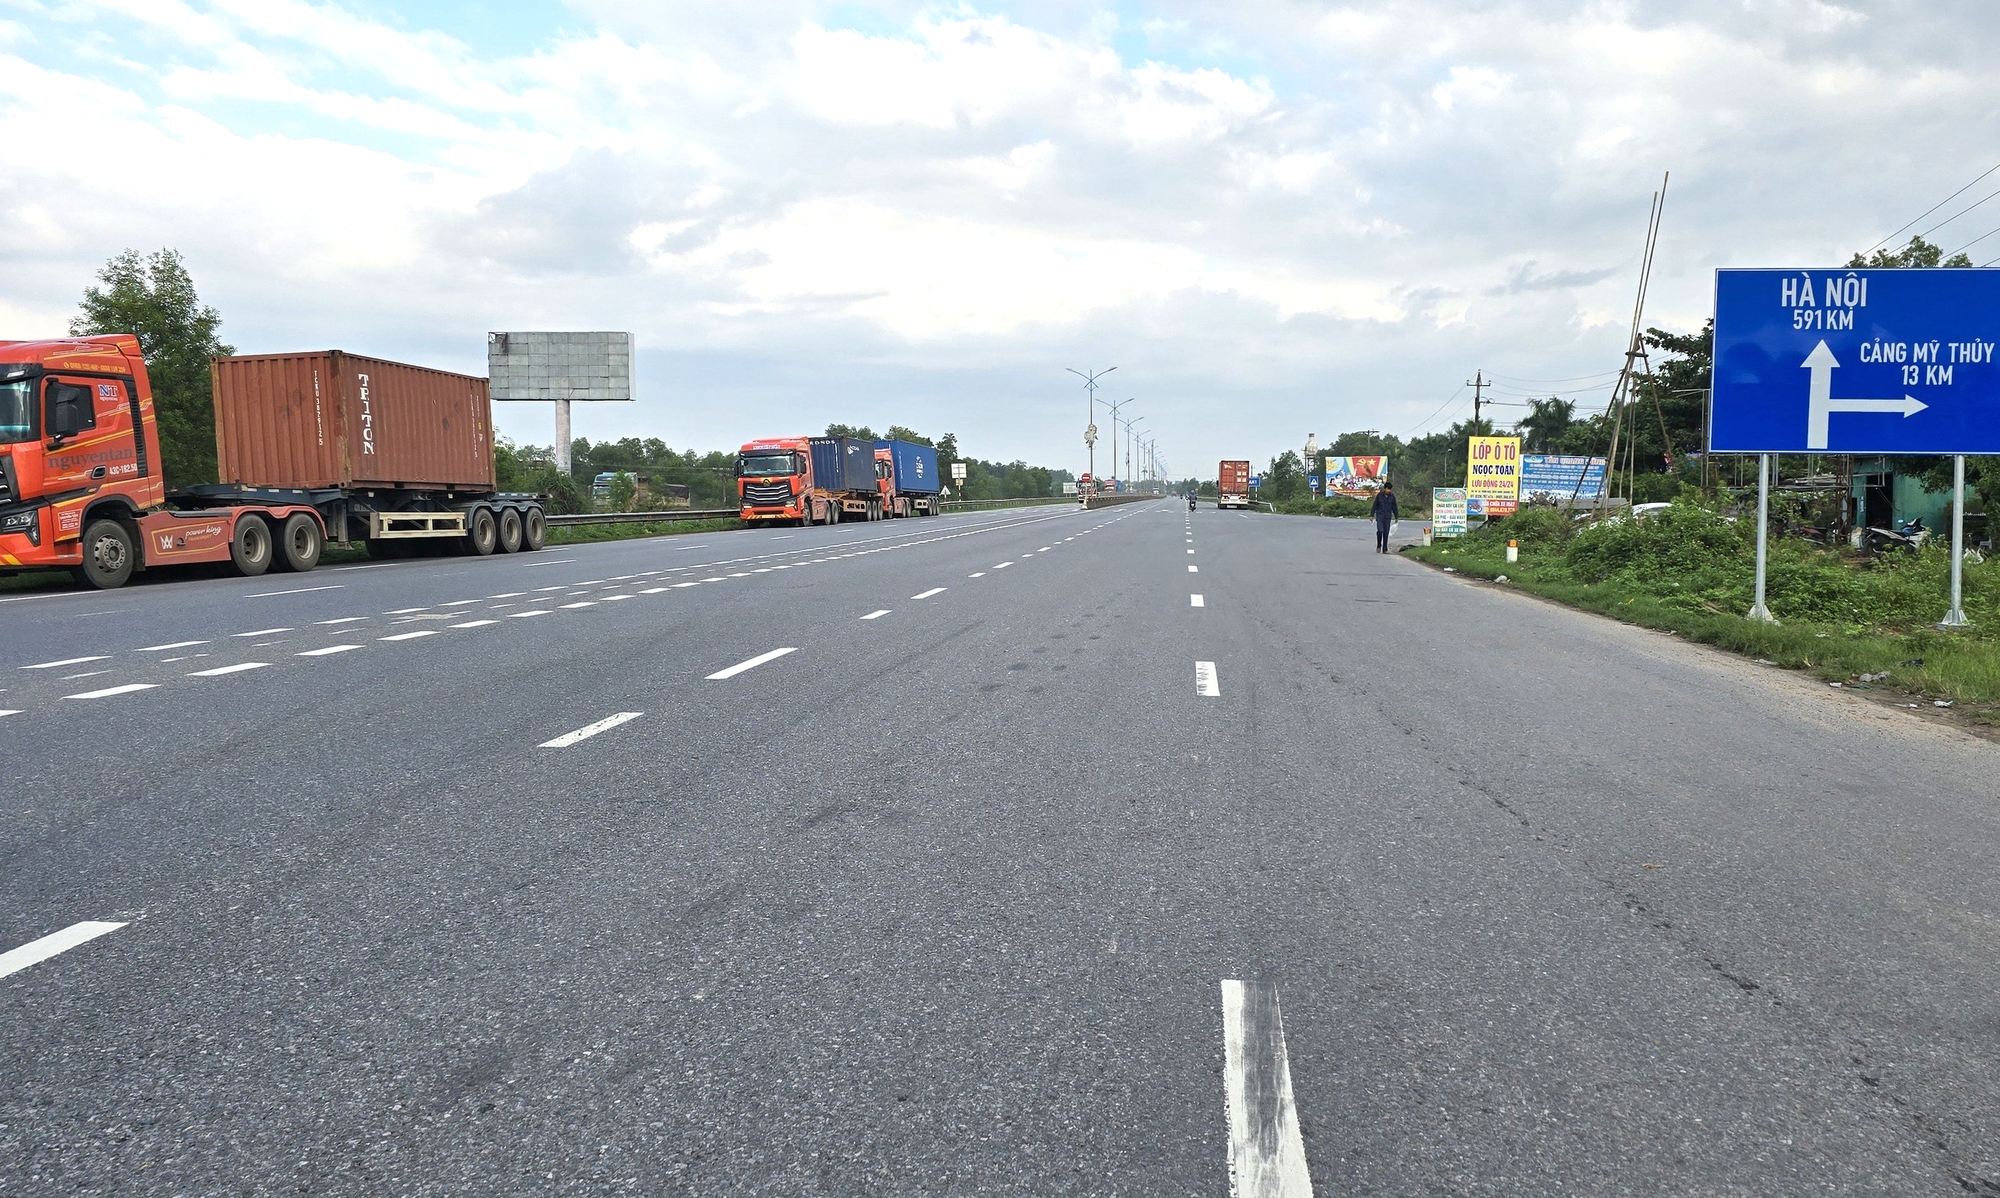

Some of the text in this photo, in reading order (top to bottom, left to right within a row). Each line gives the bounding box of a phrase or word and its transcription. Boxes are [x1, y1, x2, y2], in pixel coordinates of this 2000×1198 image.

[1781, 271, 1868, 310] HÀ NỘI
[1793, 309, 1854, 330] 591 KM
[1860, 337, 1996, 363] CẢNG MỸ THỦY
[1901, 364, 1954, 386] 13 KM
[97, 384, 118, 397] NT
[358, 373, 375, 455] TRITON
[48, 447, 133, 471] nguyentan
[1472, 438, 1516, 461] LỐP Ô TÔ
[1472, 464, 1494, 478] NGỌC
[1498, 480, 1514, 489] 24/24
